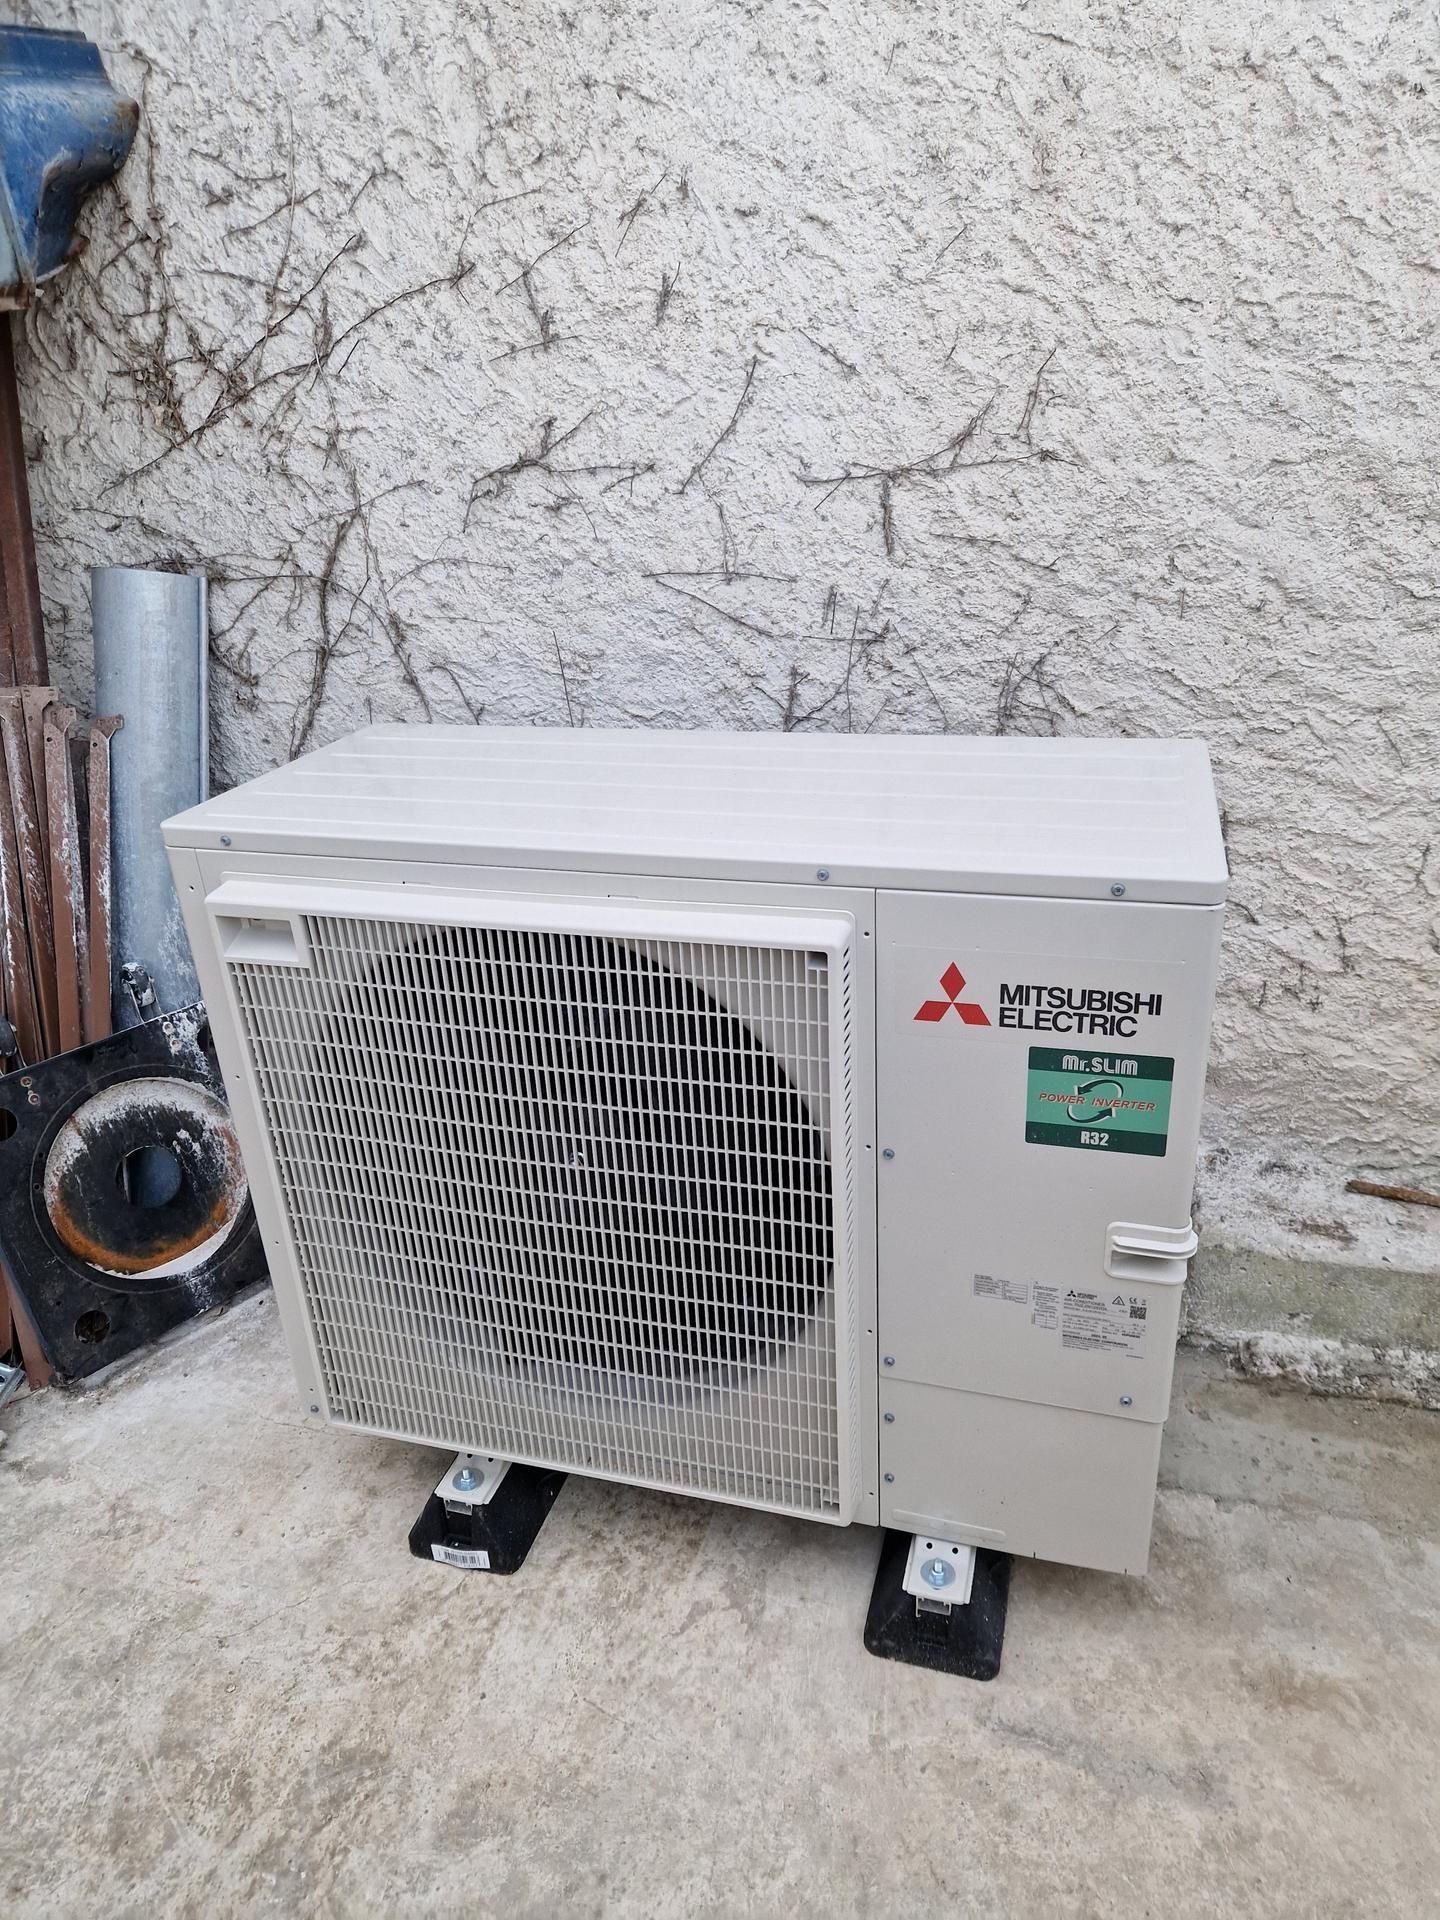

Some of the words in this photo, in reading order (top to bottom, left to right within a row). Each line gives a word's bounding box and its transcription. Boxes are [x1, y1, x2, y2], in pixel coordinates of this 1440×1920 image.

[999, 983, 1163, 1016] MITSUBISHI
[999, 1007, 1138, 1038] ELECTRIC
[1039, 1092, 1086, 1105] POWER
[1091, 1097, 1156, 1112] INVERTER
[1080, 1130, 1110, 1146] R32
